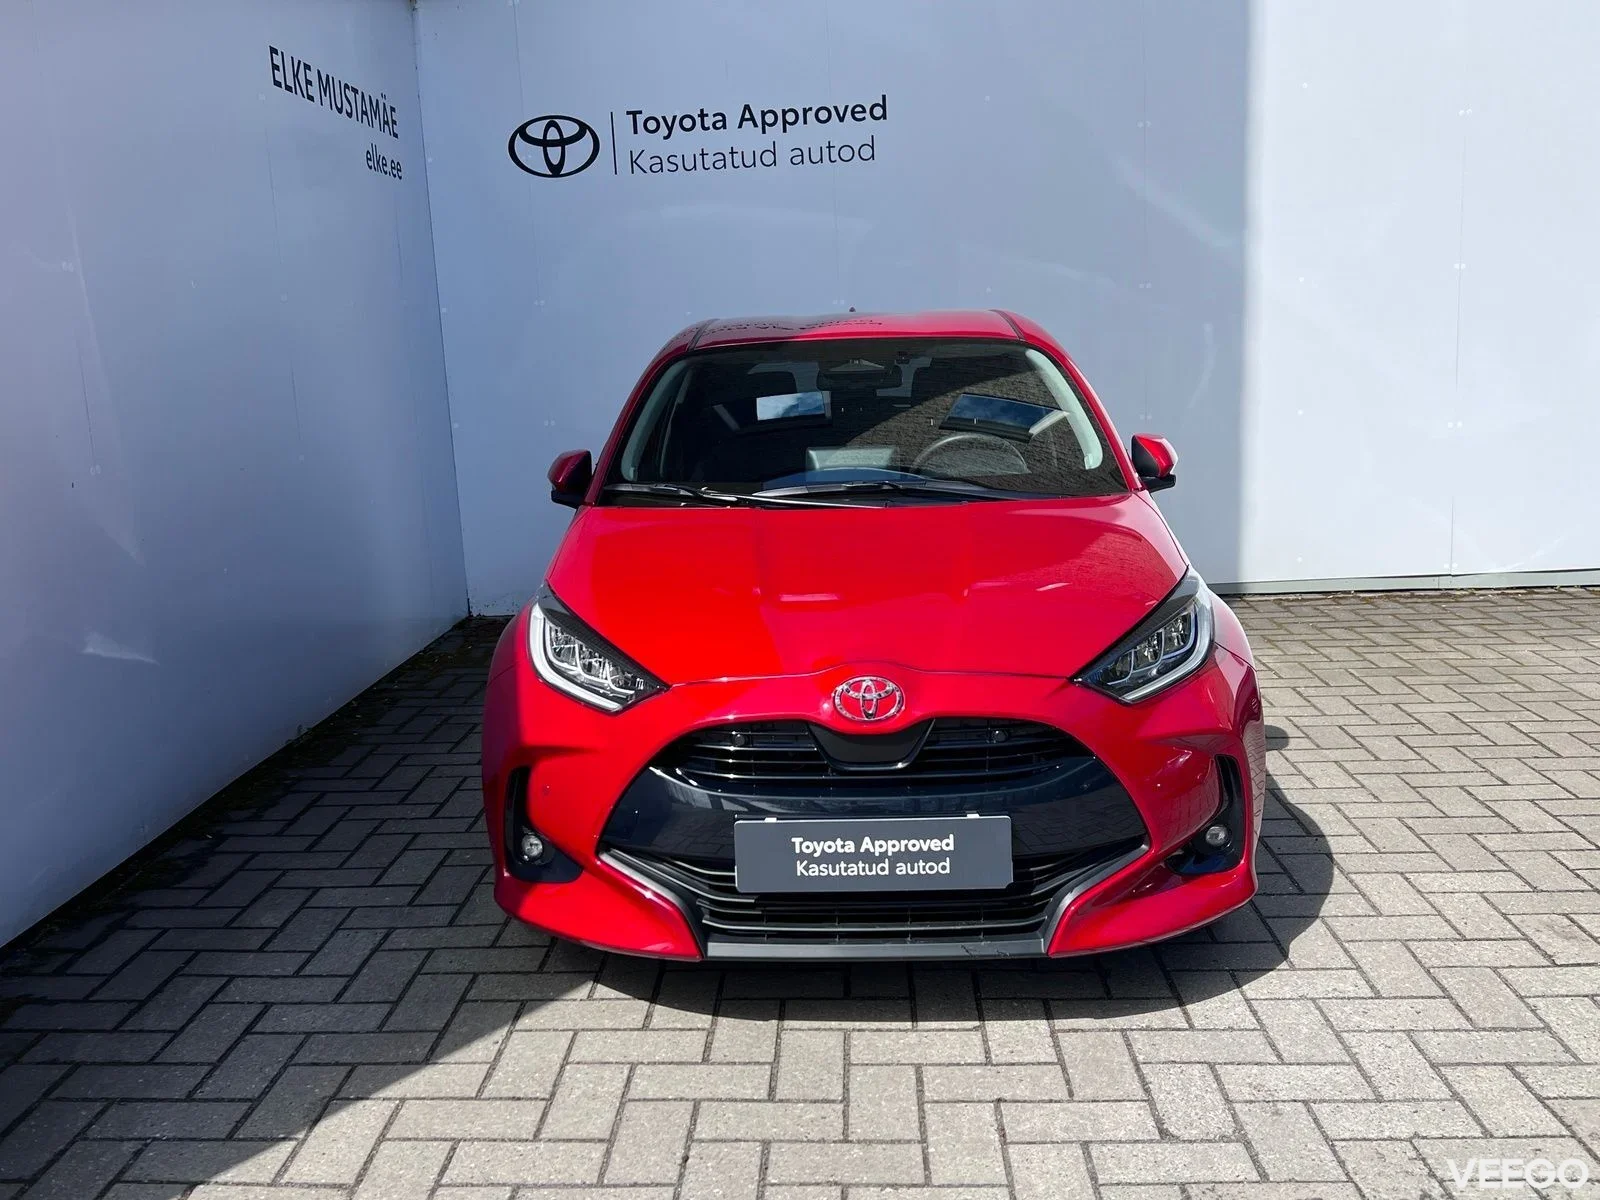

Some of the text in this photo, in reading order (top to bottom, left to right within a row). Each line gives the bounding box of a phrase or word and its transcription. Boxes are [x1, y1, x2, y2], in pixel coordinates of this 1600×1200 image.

[269, 45, 399, 139] ELKE MUSTAMÄE
[626, 94, 888, 140] Toyota Approved
[365, 143, 403, 180] elke.ee
[629, 135, 876, 175] Kasutatud autod
[791, 834, 955, 857] Toyota Approved
[796, 857, 951, 877] Kasutatud autod
